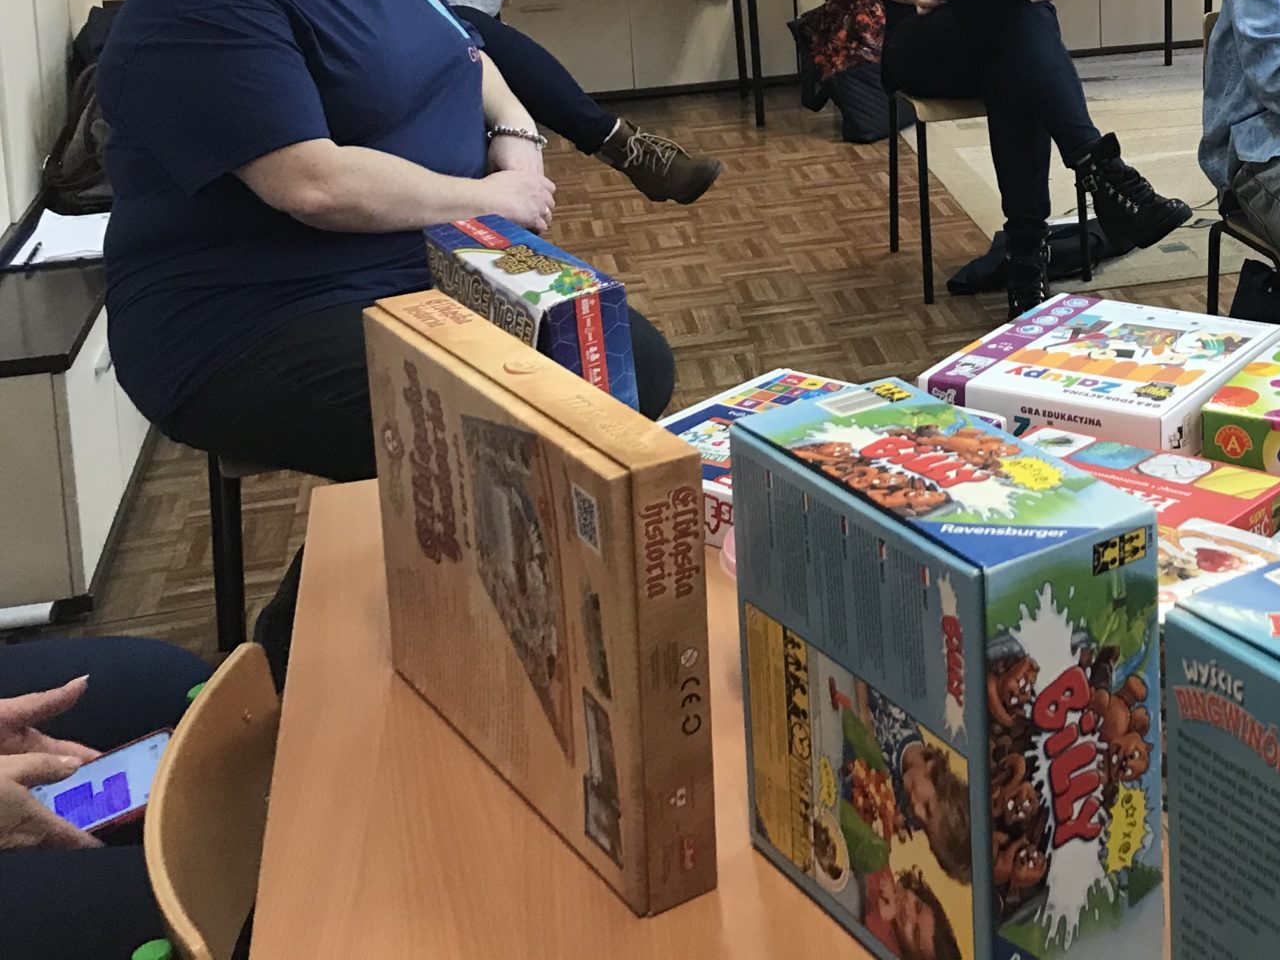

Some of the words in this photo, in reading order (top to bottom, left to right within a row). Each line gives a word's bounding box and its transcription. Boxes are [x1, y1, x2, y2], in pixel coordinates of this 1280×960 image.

[1005, 366, 1121, 394] Zakupy
[1062, 388, 1130, 405] EDUKACYJNA
[1134, 397, 1161, 410] GRA
[1021, 406, 1041, 418] GRA
[1043, 410, 1102, 428] EDUKACYJNA
[667, 485, 699, 599] Elbląska
[940, 524, 1068, 539] Ravensburger
[643, 500, 672, 601] historia
